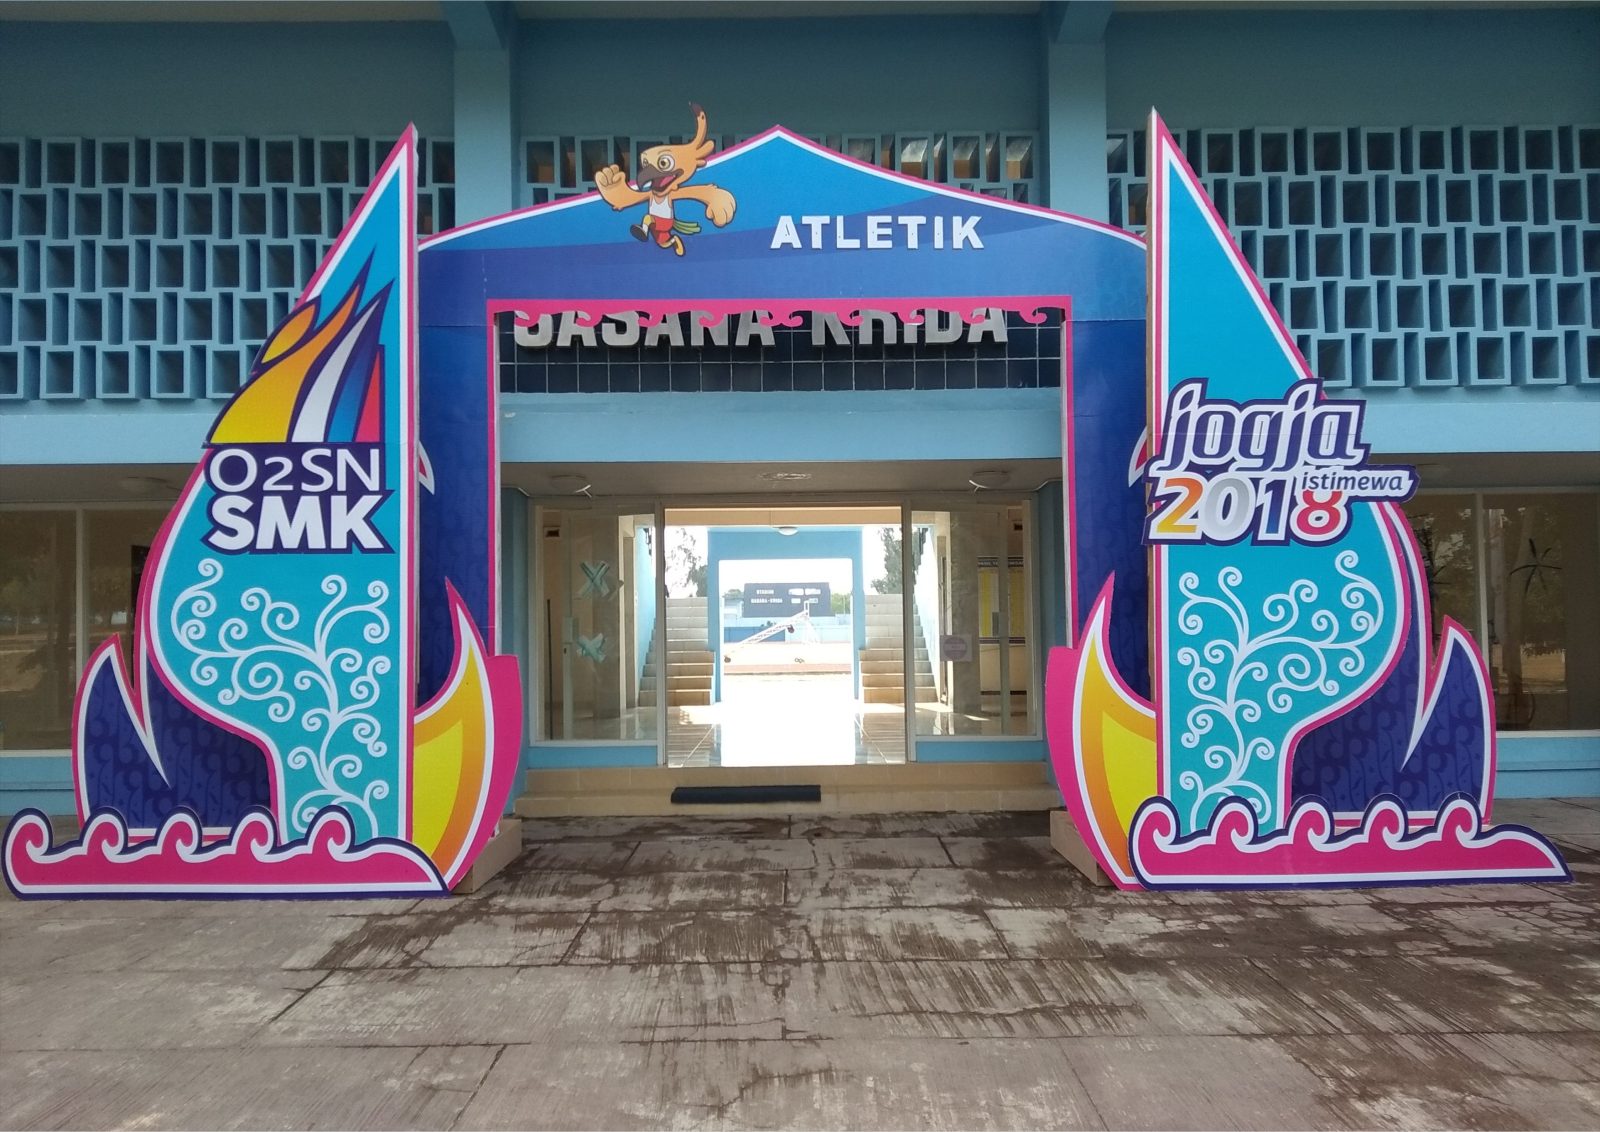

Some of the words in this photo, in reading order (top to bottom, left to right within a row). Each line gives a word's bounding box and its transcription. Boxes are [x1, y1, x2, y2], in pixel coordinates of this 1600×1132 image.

[769, 214, 985, 249] ATLETIK
[513, 309, 776, 347] SASANA
[1153, 385, 1362, 473] jogja
[209, 448, 380, 493] O2SN
[1301, 471, 1404, 491] istimewa
[207, 494, 385, 550] SMK
[1155, 476, 1342, 536] 2018
